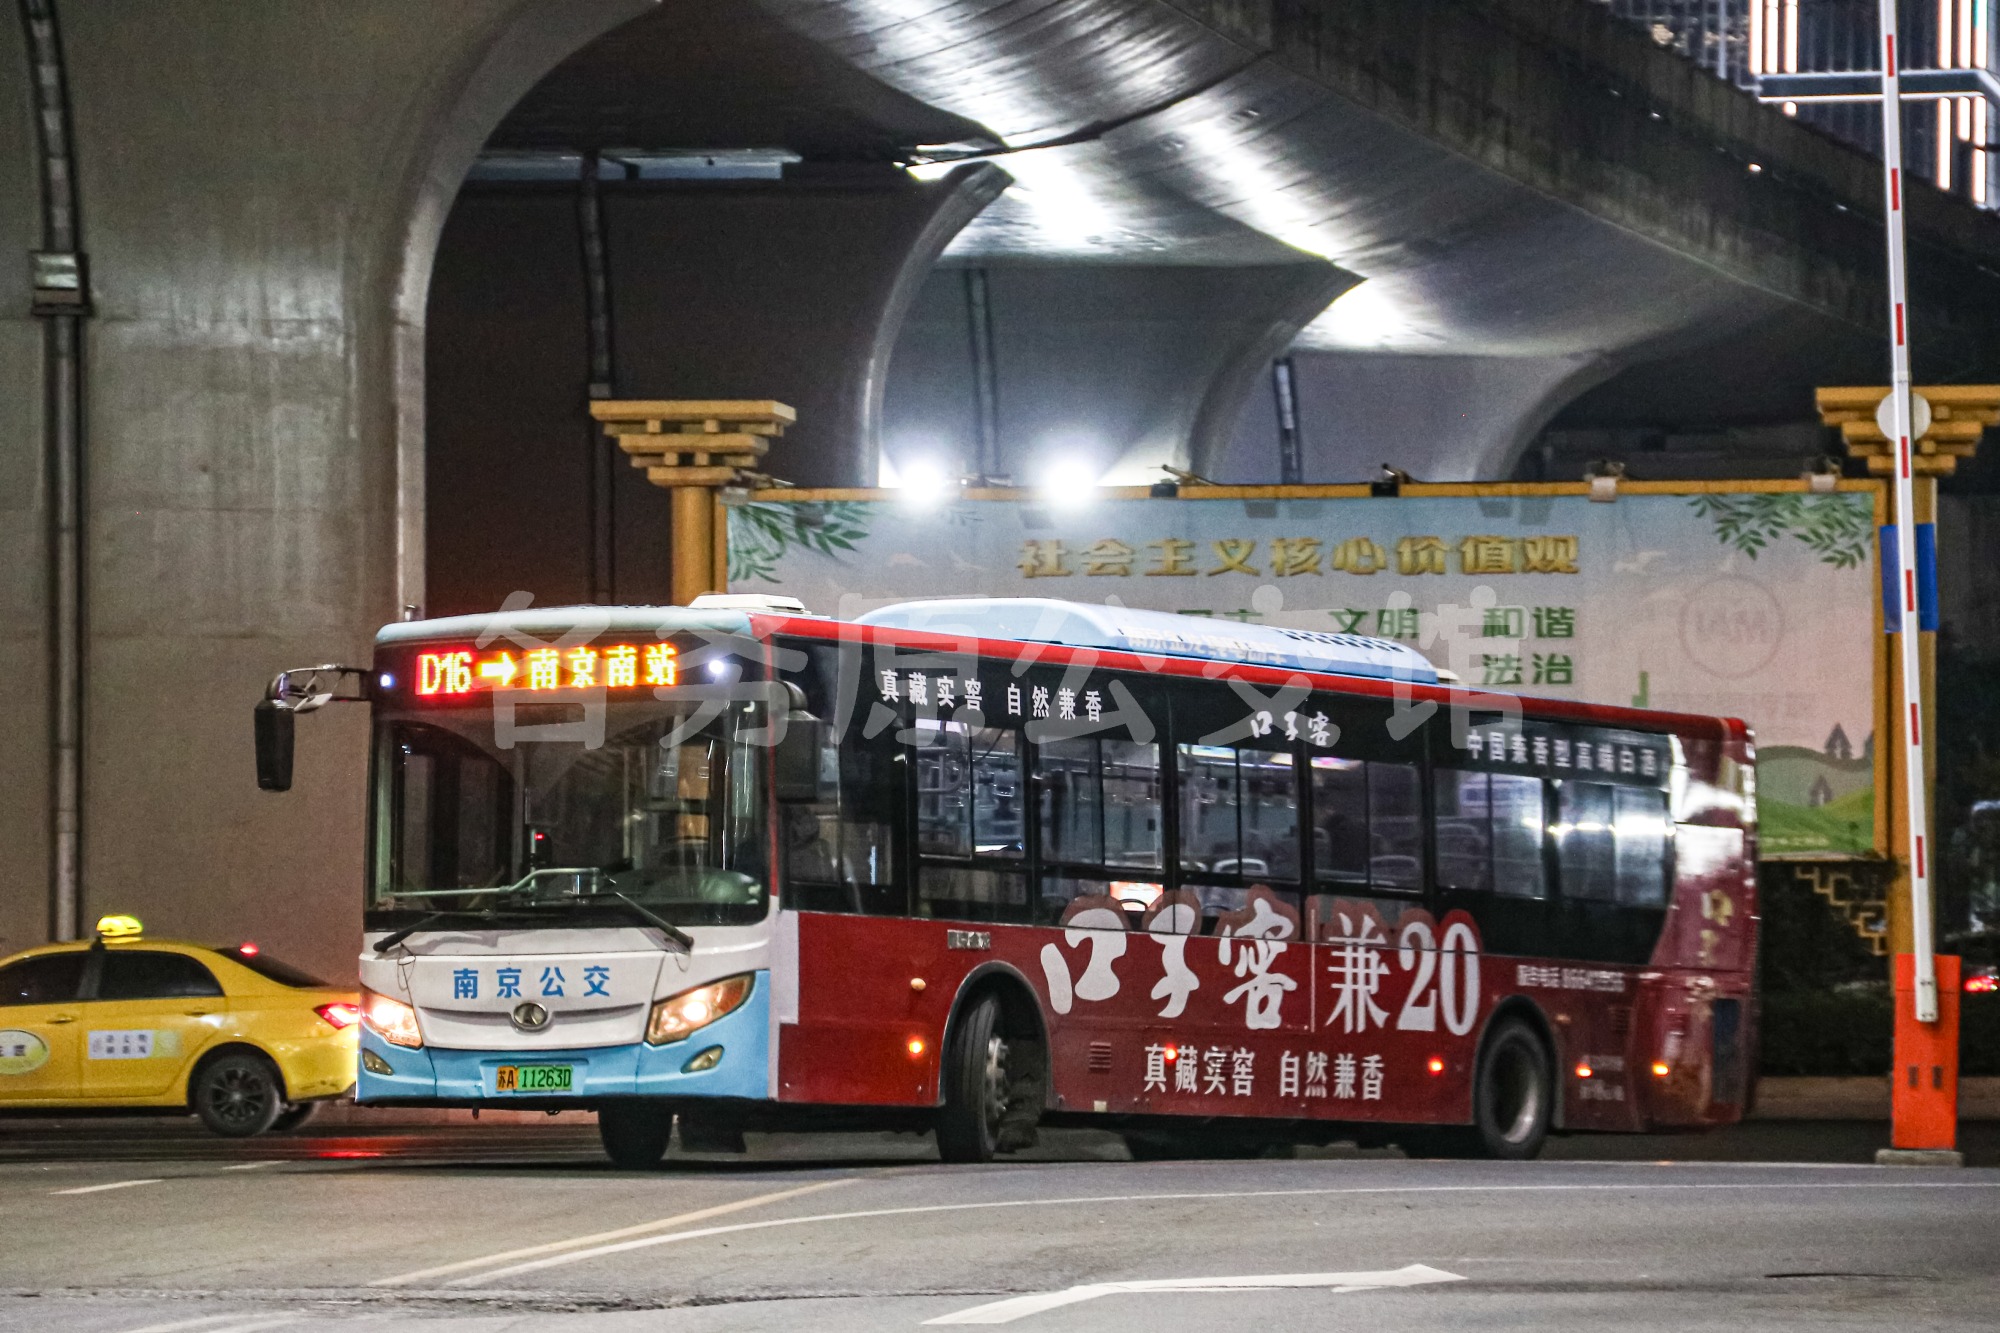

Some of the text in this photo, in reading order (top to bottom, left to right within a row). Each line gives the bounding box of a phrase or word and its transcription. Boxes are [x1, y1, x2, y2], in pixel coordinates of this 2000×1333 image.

[1018, 536, 1579, 577] 社会主义核心价值观
[1329, 606, 1575, 639] 文明 和谐
[420, 644, 679, 694] D16 南京南站
[1482, 652, 1574, 685] 法治
[880, 669, 1102, 722] 真藏实窖 自然兼香
[453, 965, 610, 999] 南京公交
[1040, 897, 1298, 1030] 口子窖
[1143, 1042, 1385, 1100] 真藏实窖 自然兼香
